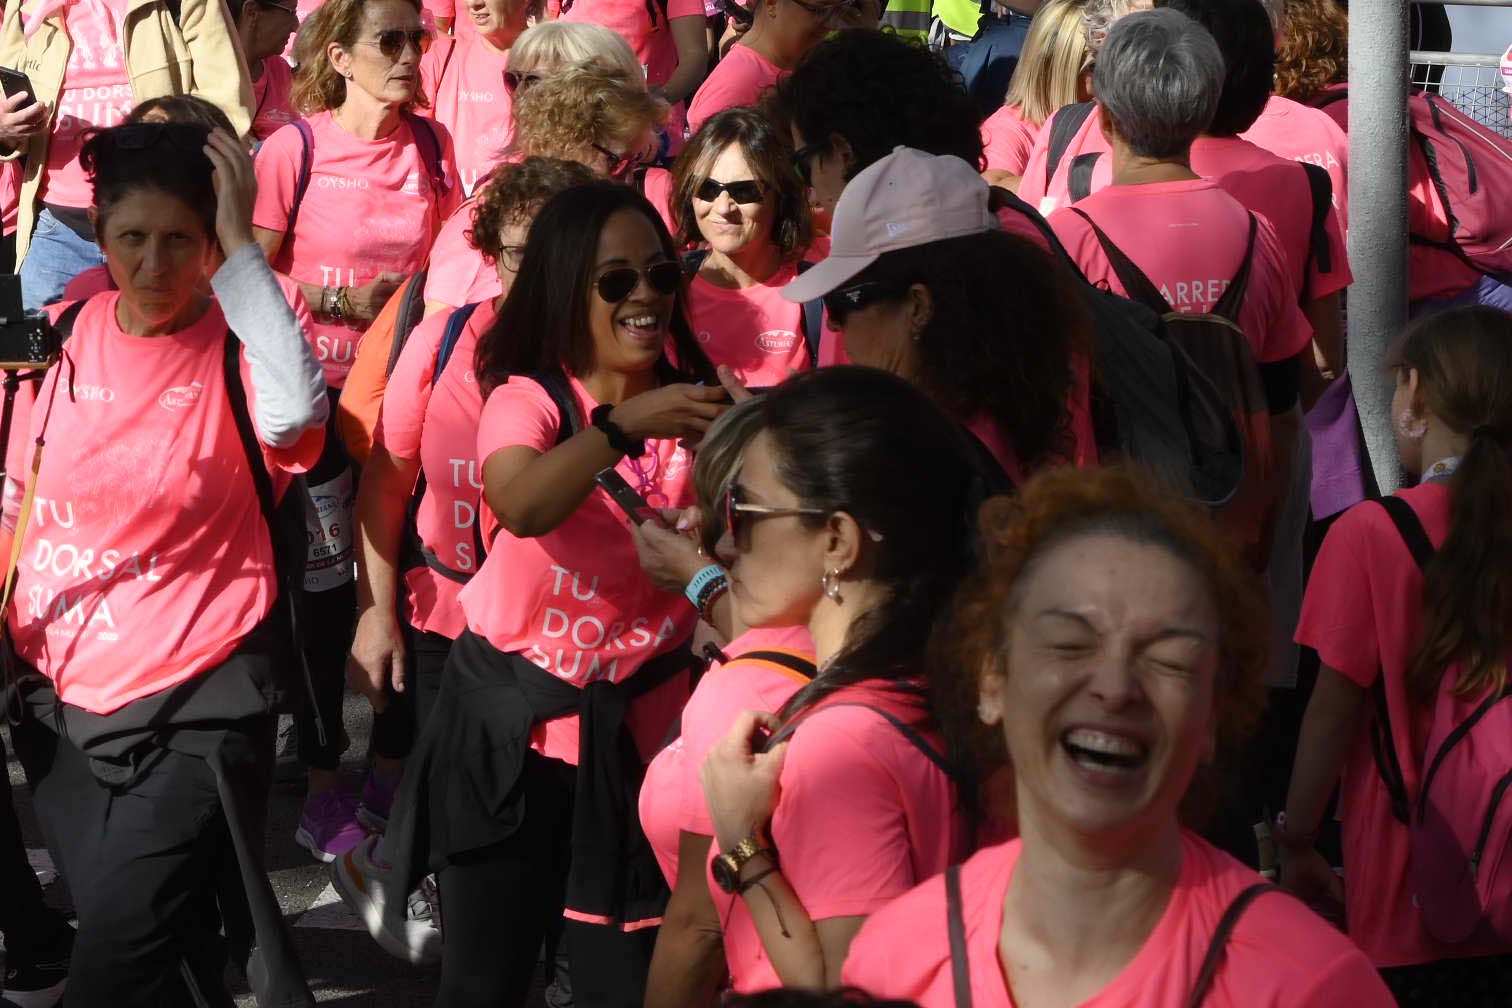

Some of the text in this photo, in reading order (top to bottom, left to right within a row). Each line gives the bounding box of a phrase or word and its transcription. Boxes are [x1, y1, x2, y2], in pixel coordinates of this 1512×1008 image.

[318, 176, 369, 190] OYSHO
[316, 336, 353, 362] SU
[34, 496, 74, 529] TU
[33, 539, 162, 582] DORSAL
[551, 564, 600, 601] TU
[28, 583, 116, 628] SUMA
[541, 607, 677, 650] DORSA
[531, 643, 619, 684] SUM
